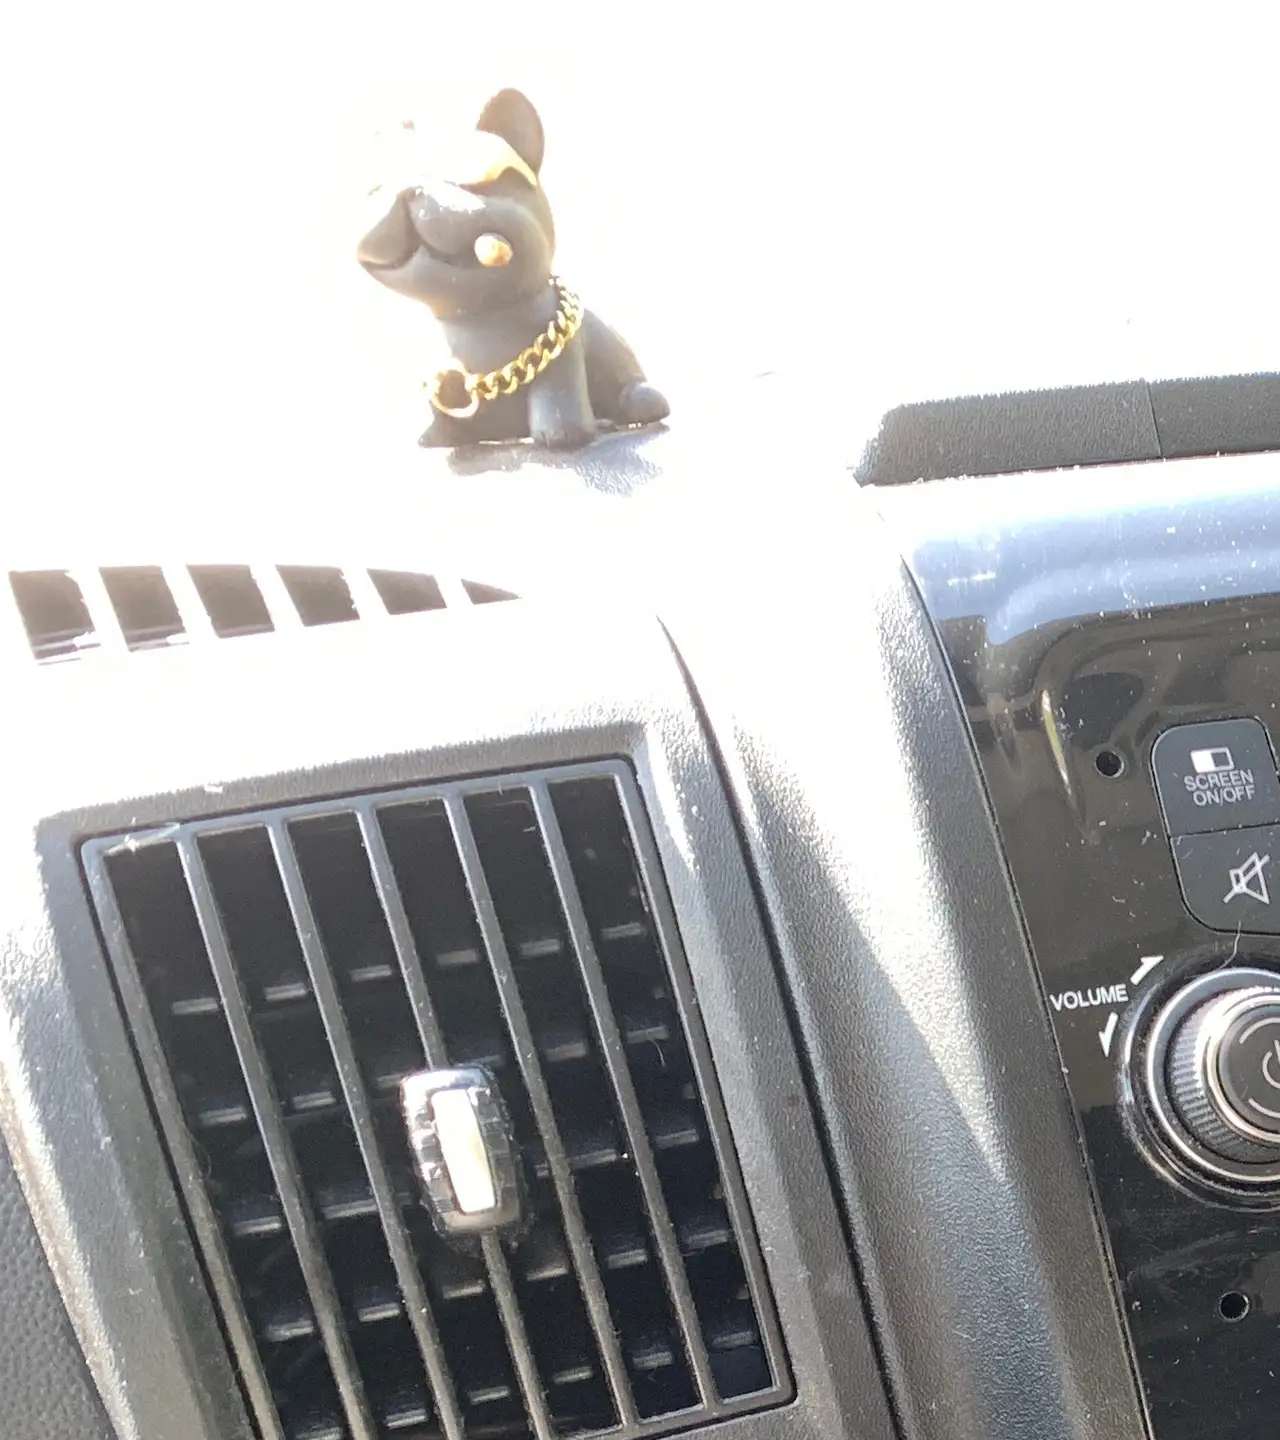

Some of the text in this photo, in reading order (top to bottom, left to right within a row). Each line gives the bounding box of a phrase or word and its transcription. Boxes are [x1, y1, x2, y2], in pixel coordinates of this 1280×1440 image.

[1184, 769, 1253, 795] SCREEN
[1192, 782, 1256, 806] ON/OFF
[1050, 984, 1129, 1011] VOLUME
